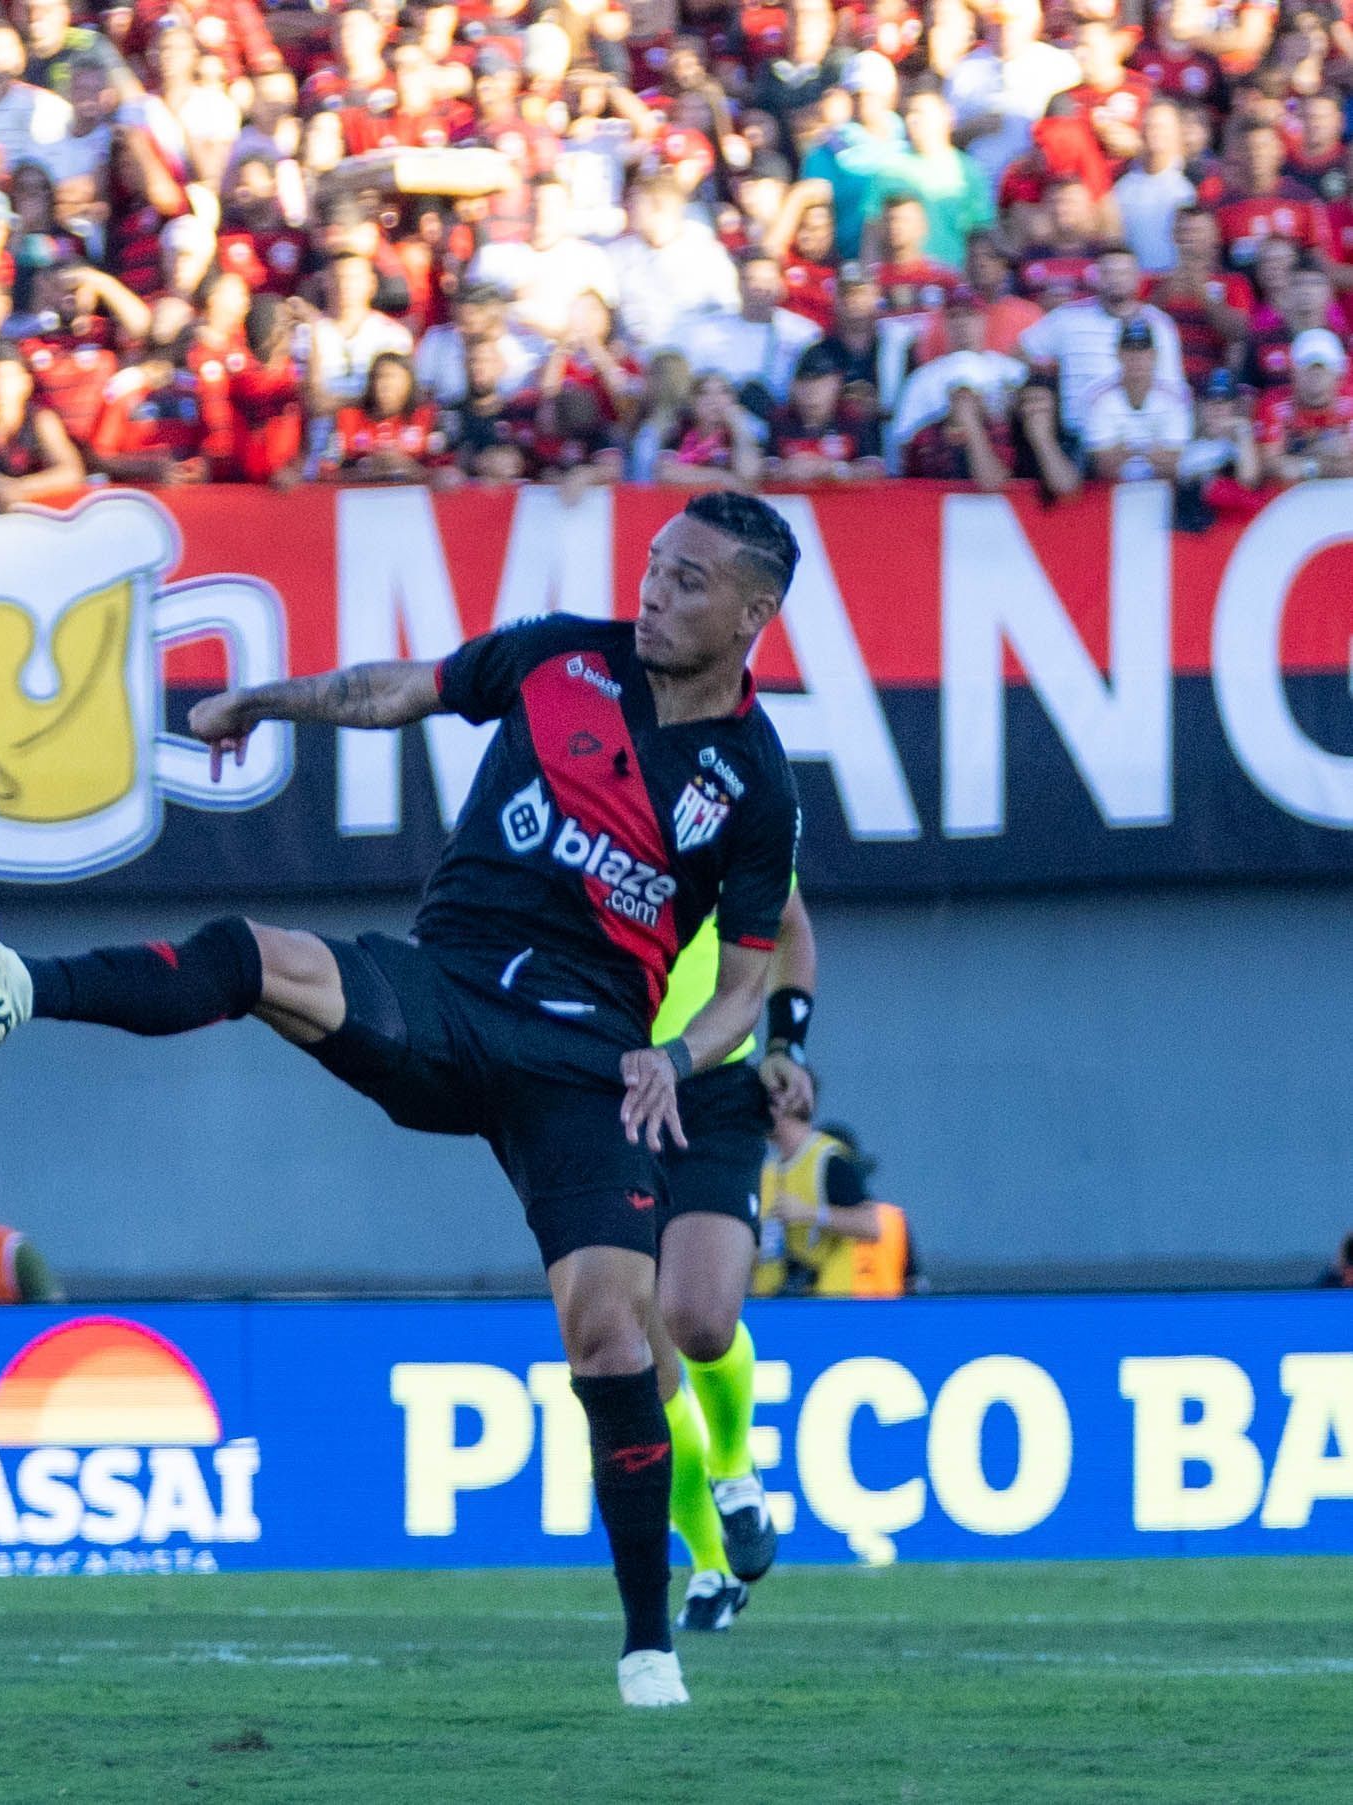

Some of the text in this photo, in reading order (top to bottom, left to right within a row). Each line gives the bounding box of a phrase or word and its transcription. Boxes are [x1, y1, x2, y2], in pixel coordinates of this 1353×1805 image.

[583, 666, 622, 699] blaze
[552, 818, 677, 905] blaze
[605, 889, 658, 928] .com
